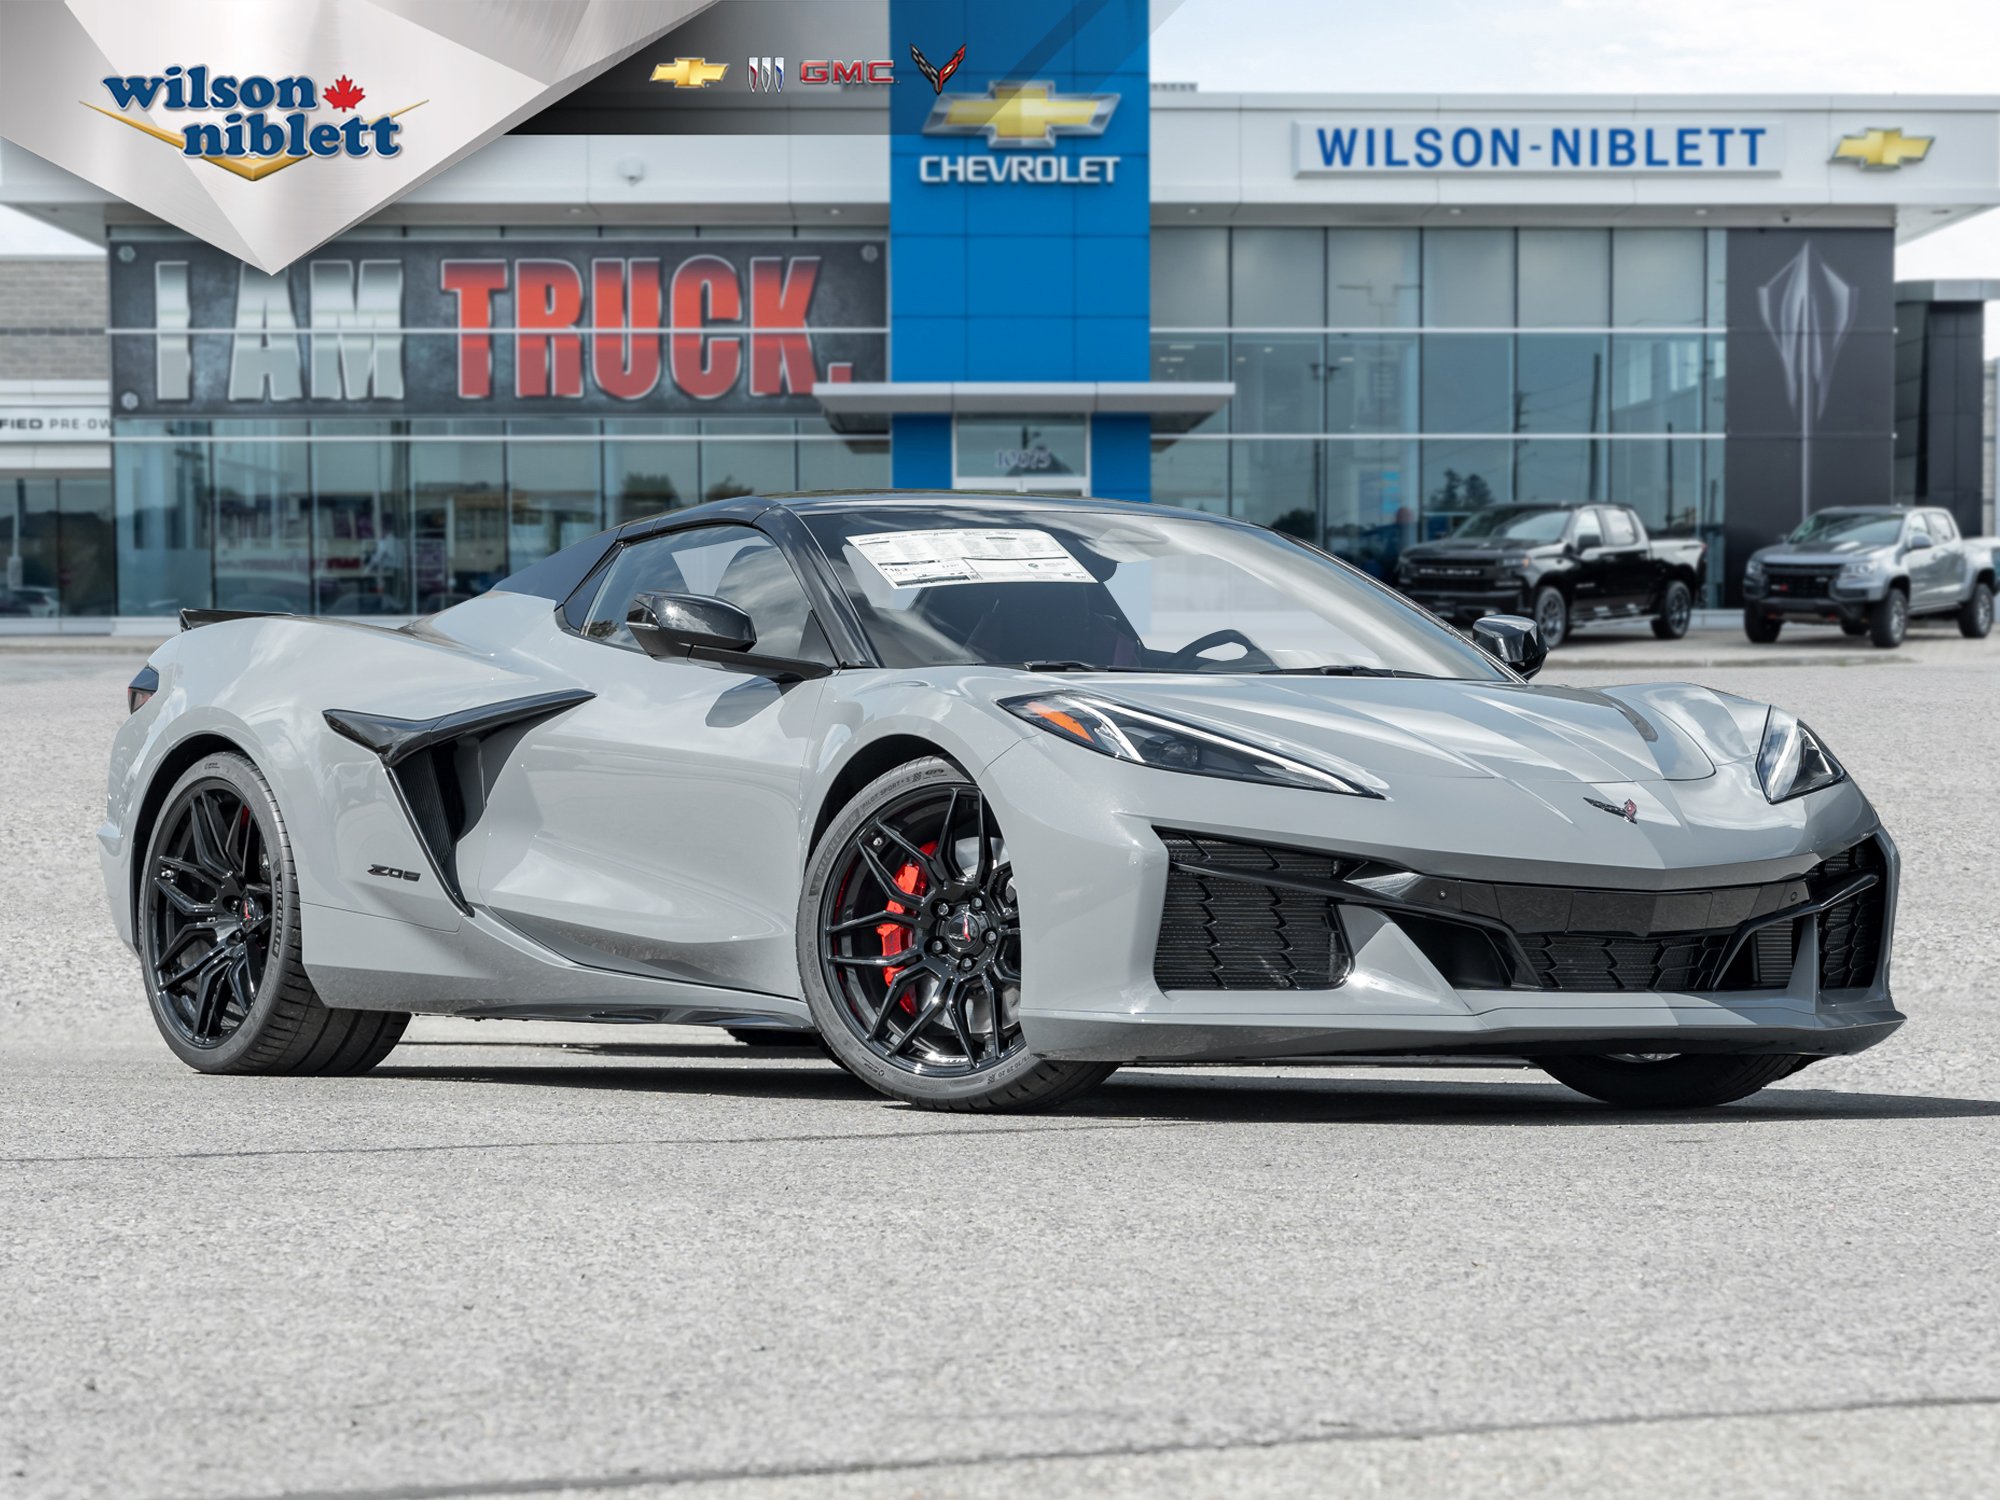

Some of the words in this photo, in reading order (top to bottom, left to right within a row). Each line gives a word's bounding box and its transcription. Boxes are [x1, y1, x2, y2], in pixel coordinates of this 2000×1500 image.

[920, 156, 1120, 183] CHEVROLET
[1317, 127, 1767, 168] WILSON-NIBLETT
[155, 261, 191, 400] I
[228, 258, 404, 401] AM
[880, 781, 901, 797] SPORT
[816, 810, 858, 878] MICHELIN
[273, 880, 283, 954] MICHELIN
